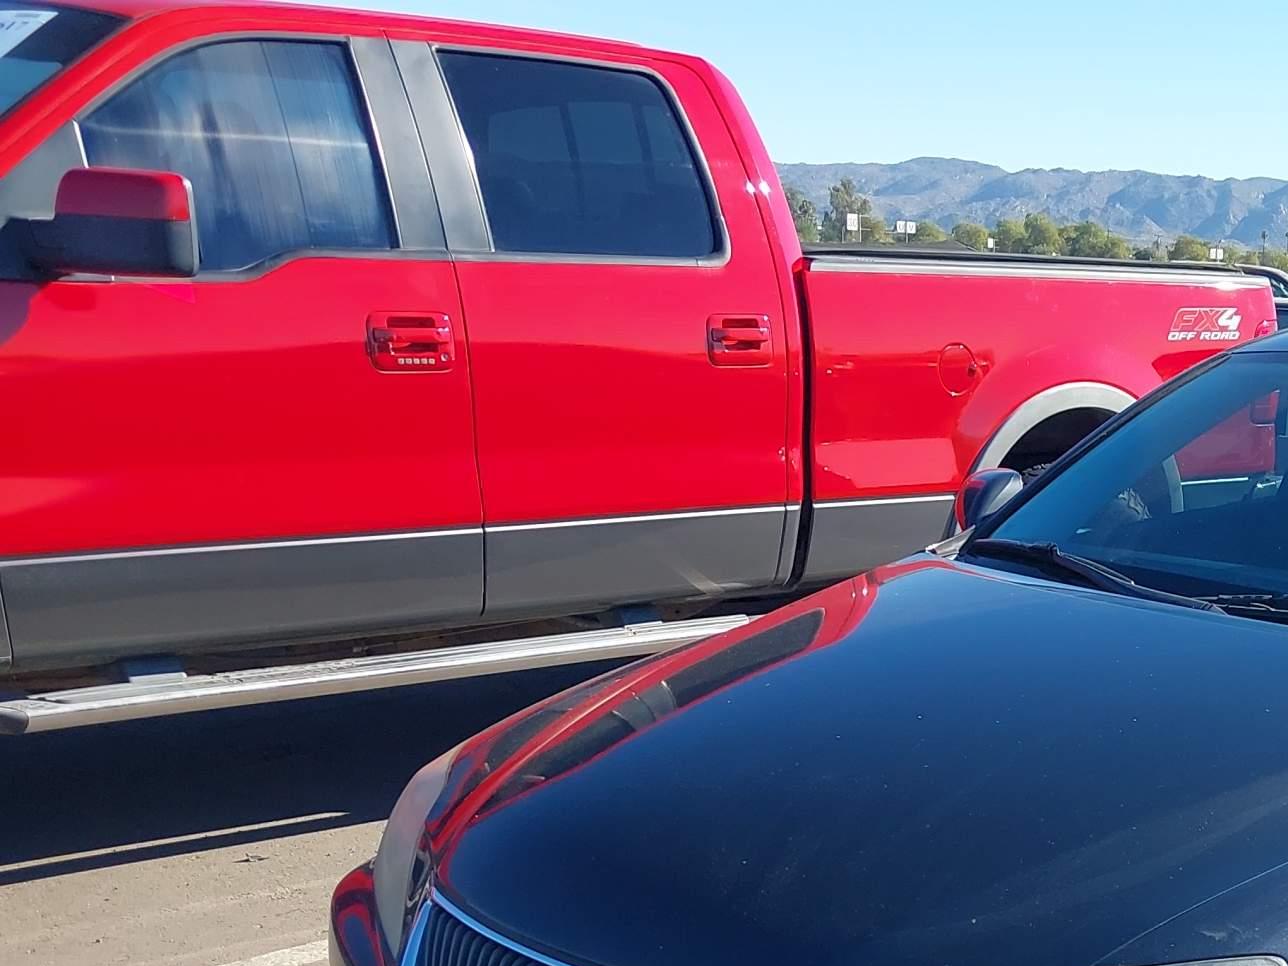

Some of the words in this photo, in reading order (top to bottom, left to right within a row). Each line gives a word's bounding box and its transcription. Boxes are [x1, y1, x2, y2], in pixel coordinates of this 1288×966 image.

[1170, 307, 1242, 331] FX4
[1167, 331, 1197, 341] OFF
[1200, 331, 1240, 341] ROAD
